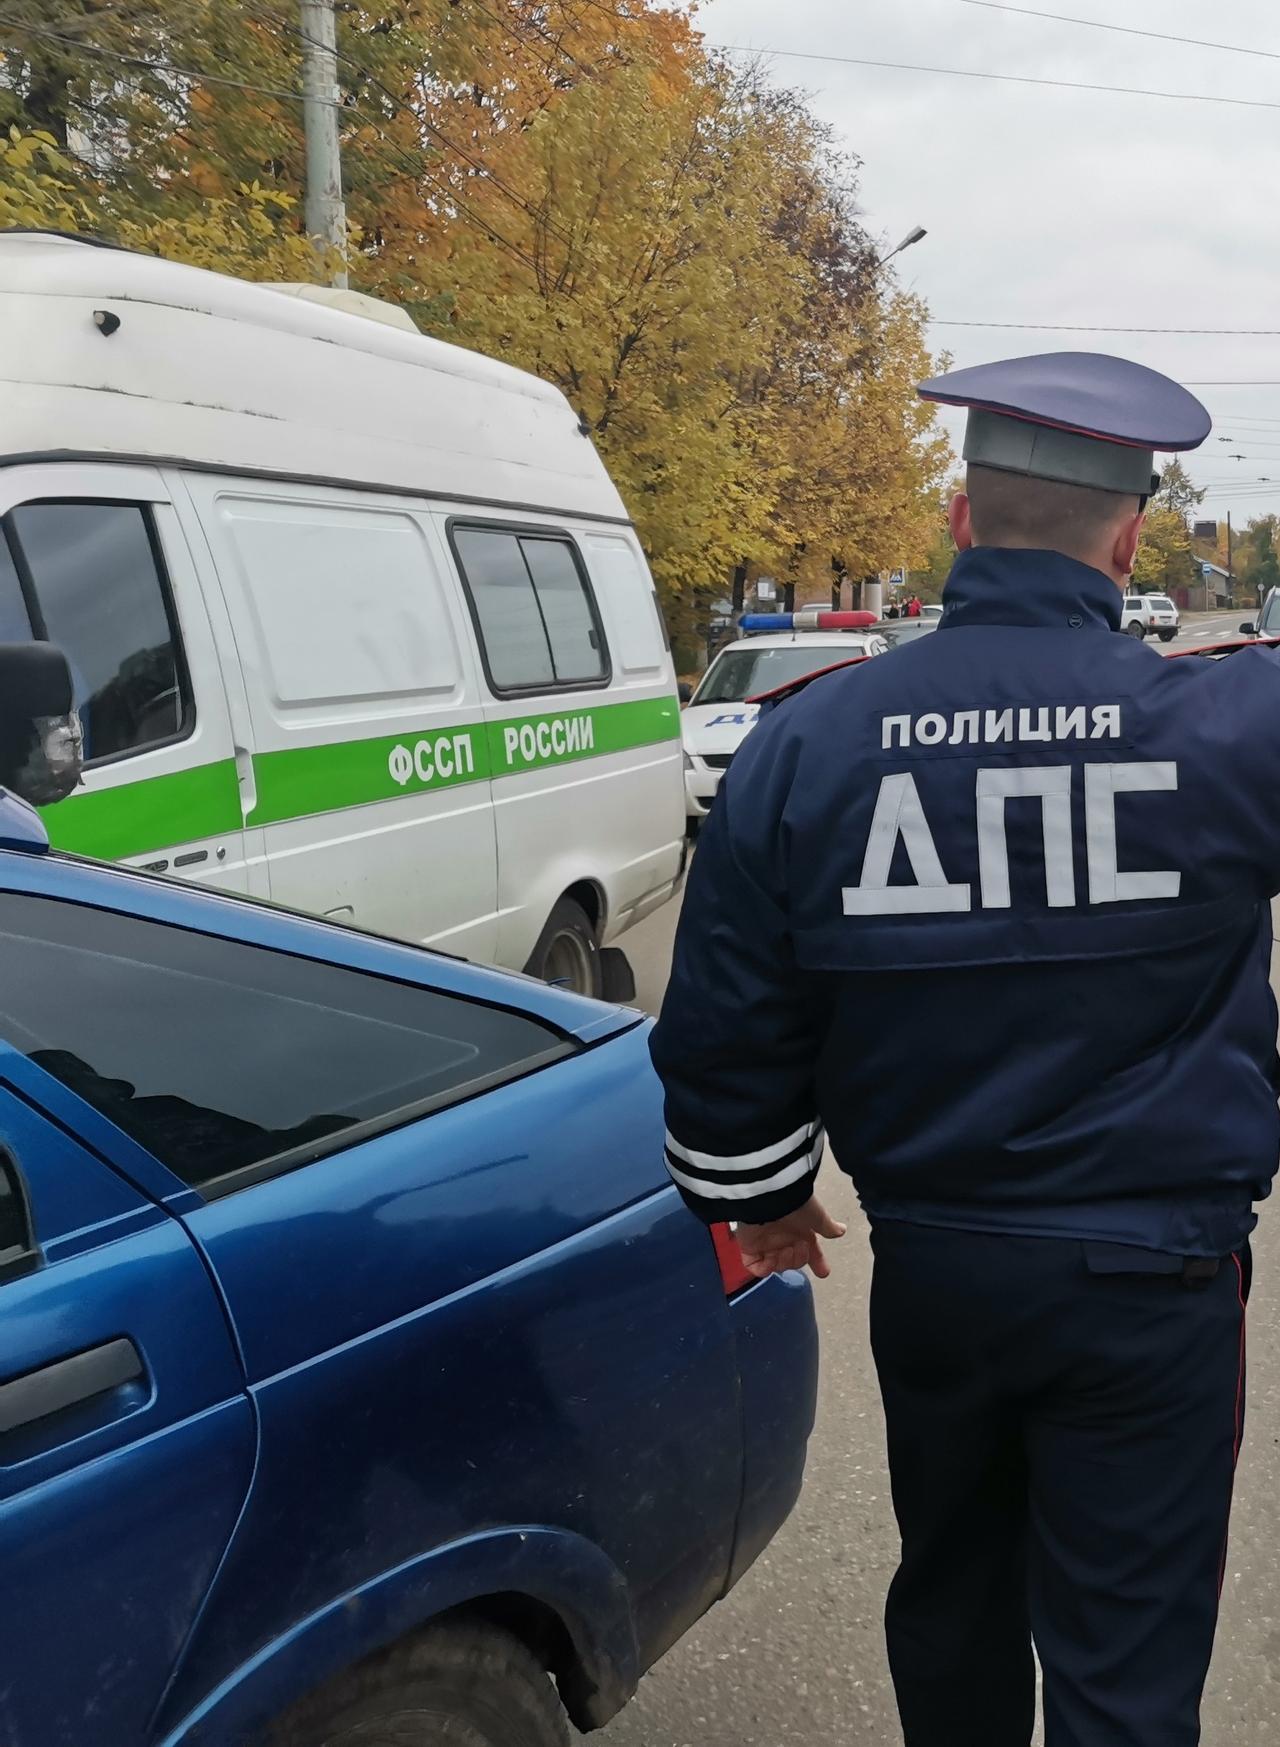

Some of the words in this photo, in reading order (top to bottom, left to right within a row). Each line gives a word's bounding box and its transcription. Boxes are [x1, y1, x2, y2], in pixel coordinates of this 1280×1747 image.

[388, 733, 474, 786] ФССП
[504, 715, 595, 765] РОССИИ
[881, 704, 1121, 749] ПОЛИЦИЯ
[841, 761, 1182, 916] ДПС
